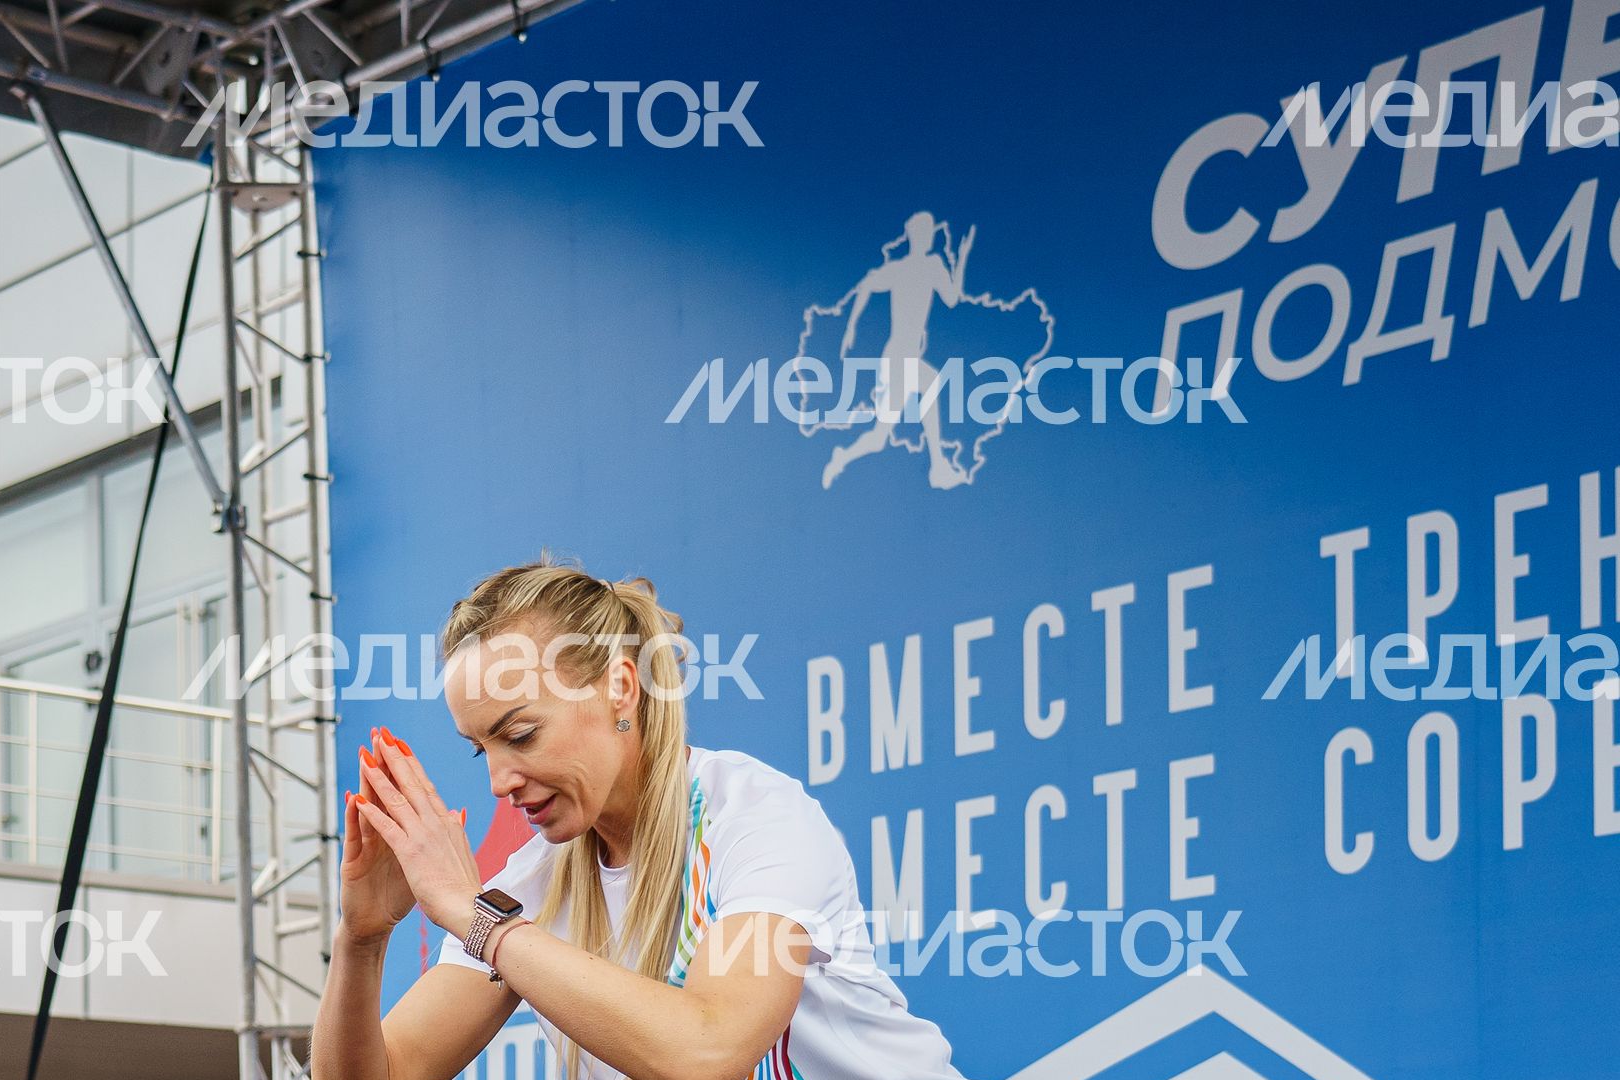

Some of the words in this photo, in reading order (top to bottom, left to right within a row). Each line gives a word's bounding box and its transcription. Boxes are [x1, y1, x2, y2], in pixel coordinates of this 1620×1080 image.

[1152, 177, 1620, 419] ПОДМ
[807, 564, 1214, 786] ВМЕСТЕ
[835, 754, 1215, 946] МЕСТЕ
